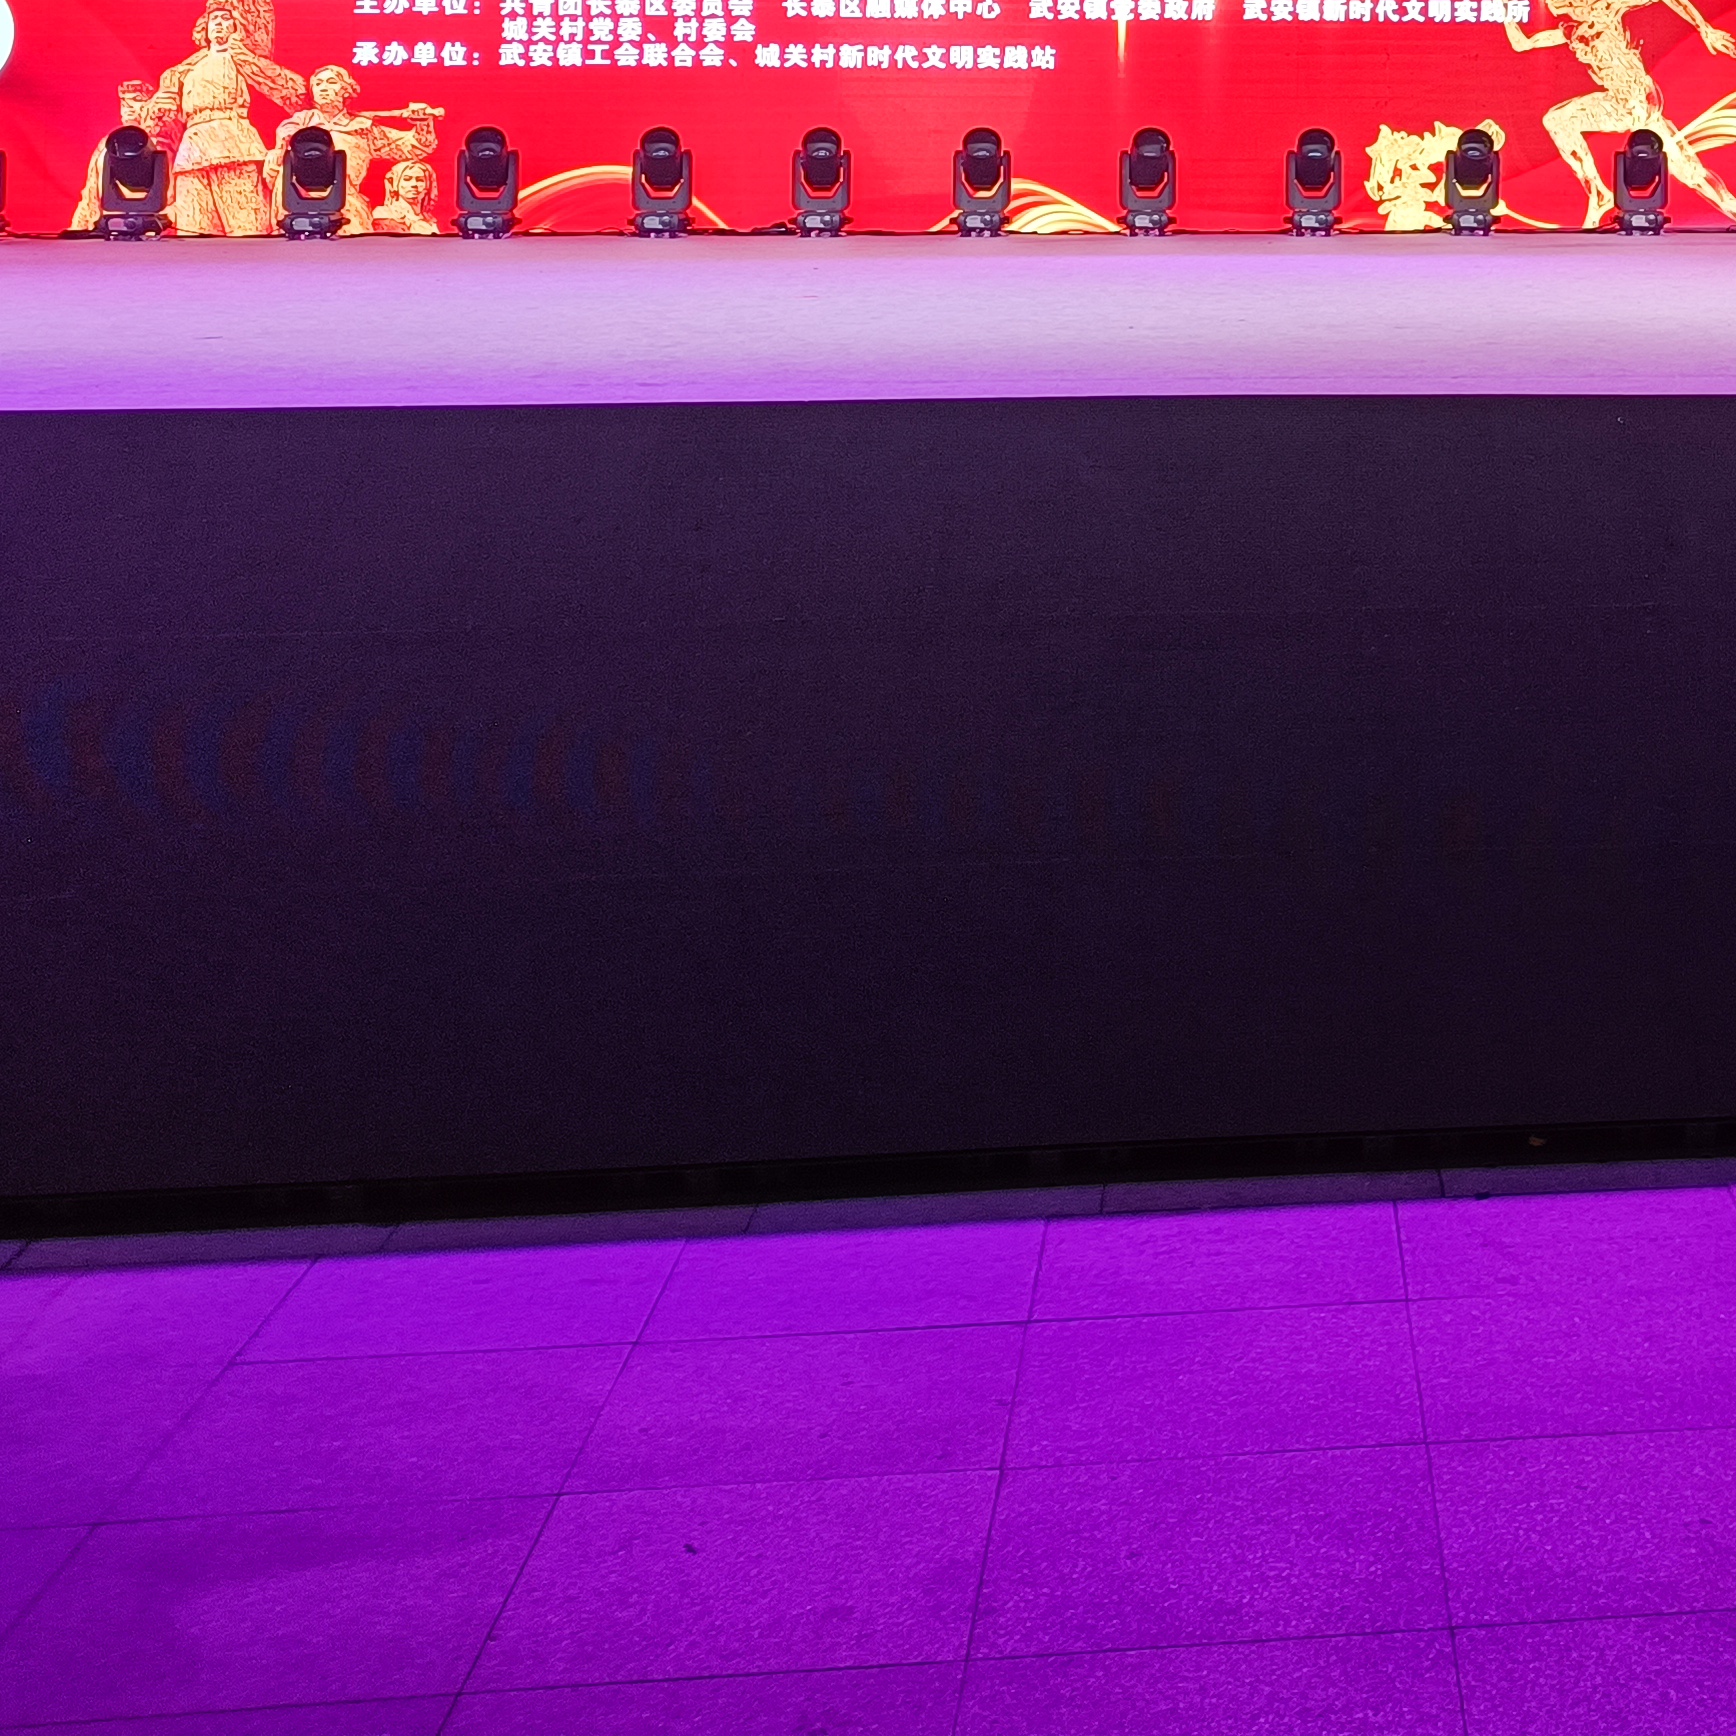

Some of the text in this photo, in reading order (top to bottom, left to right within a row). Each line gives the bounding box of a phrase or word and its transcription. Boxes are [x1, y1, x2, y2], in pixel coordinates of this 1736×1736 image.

[502, 17, 757, 42] 城关村党委、村委会
